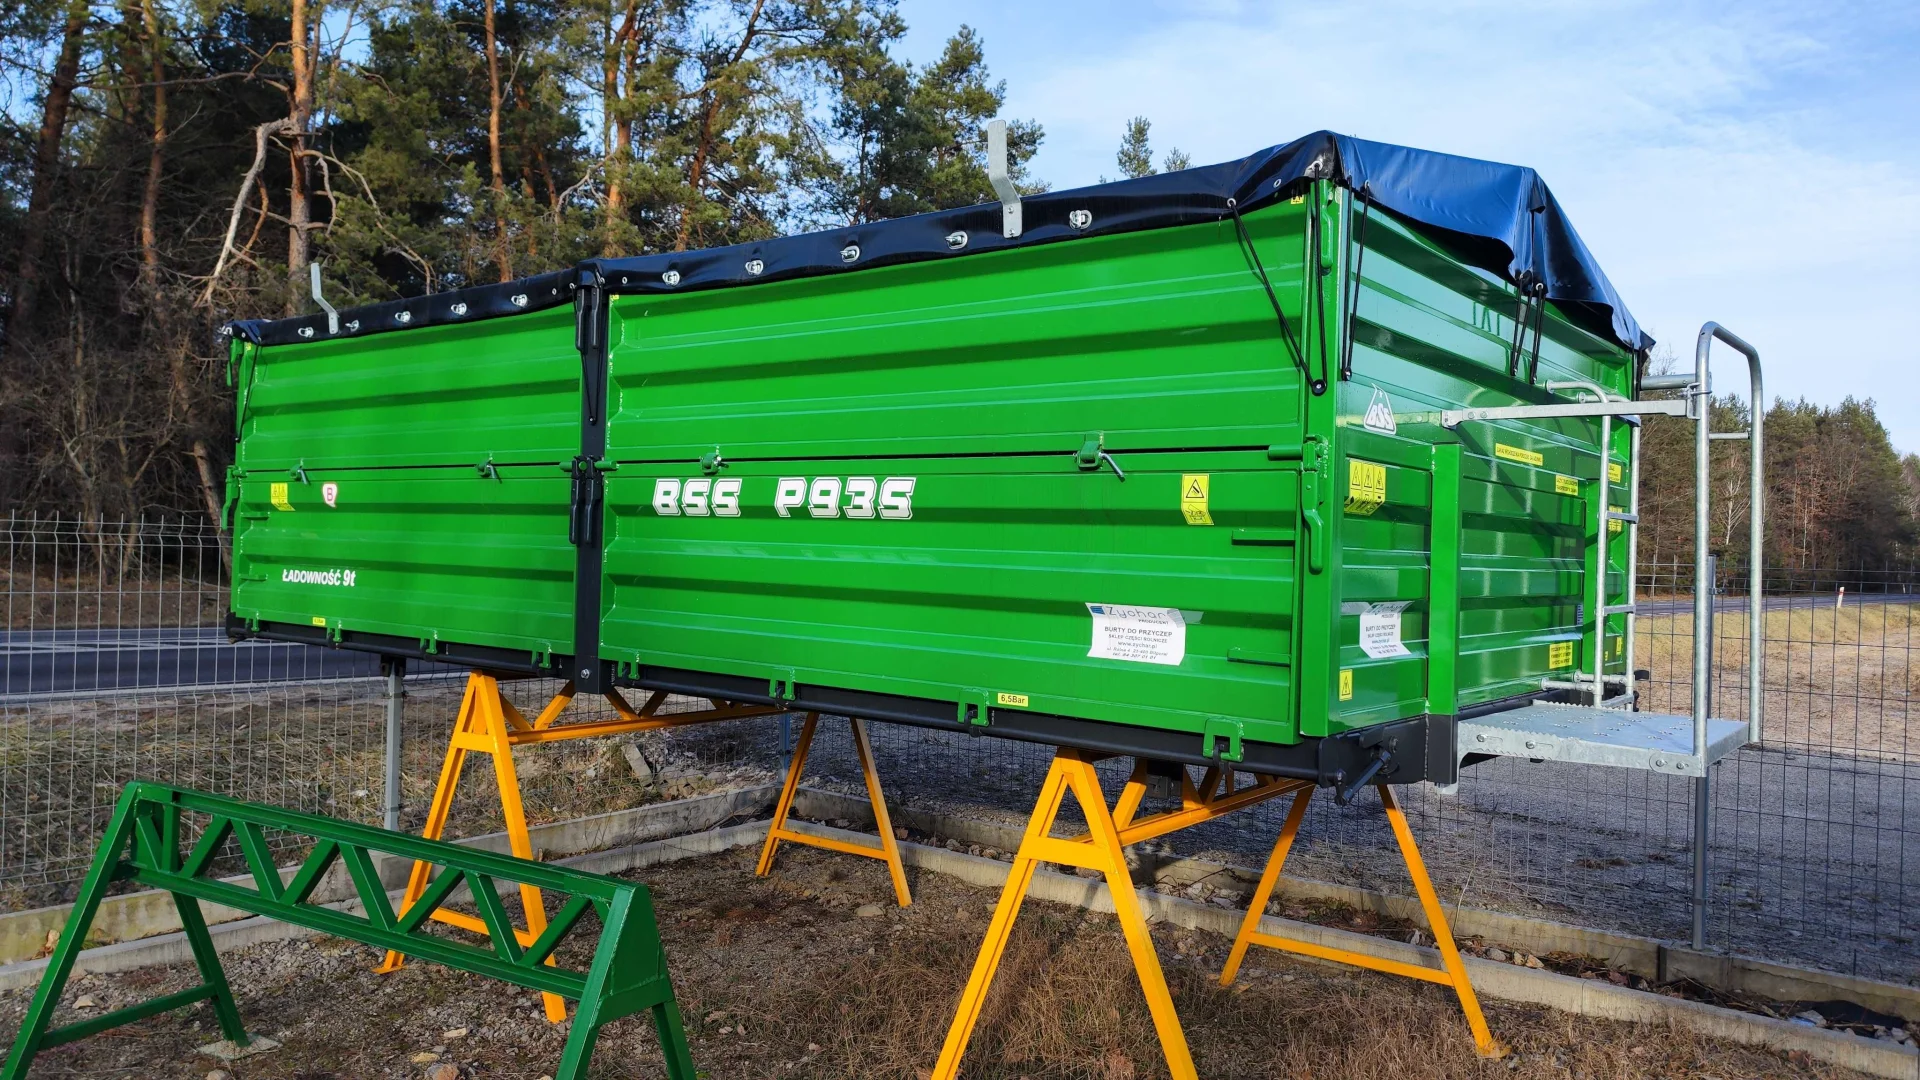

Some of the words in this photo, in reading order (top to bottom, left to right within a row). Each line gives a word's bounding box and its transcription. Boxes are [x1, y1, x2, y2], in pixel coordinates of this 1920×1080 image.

[1365, 402, 1394, 431] BSS
[652, 478, 743, 518] BSS
[774, 476, 917, 520] P93S
[282, 568, 341, 586] ŁADOWNOŚĆ
[343, 569, 356, 587] 9t
[1138, 629, 1173, 637] PRZYCZEP
[1118, 641, 1158, 649] www.zychar.pl
[1000, 694, 1026, 704] 6,5Bar
